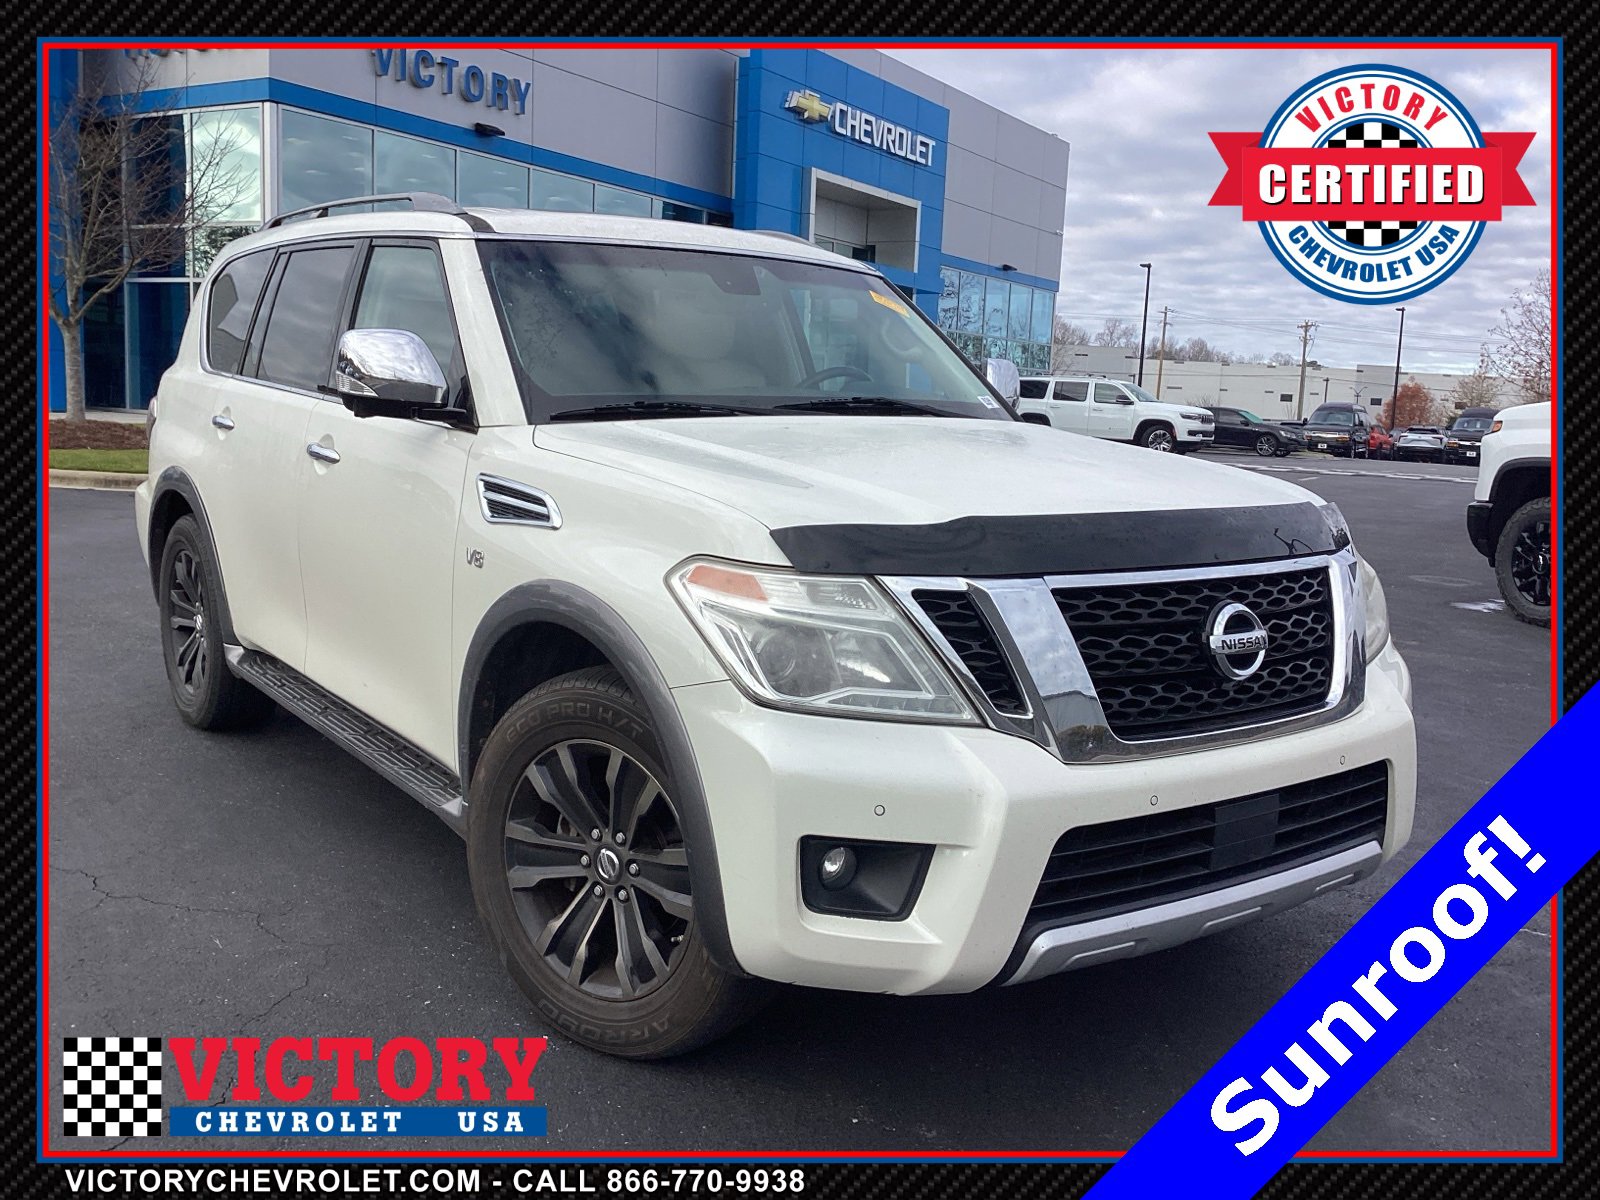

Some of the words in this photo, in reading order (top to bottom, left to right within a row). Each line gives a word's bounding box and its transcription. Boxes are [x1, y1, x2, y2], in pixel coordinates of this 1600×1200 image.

[374, 48, 531, 115] VICTORY
[833, 102, 936, 166] CHEVROLET
[466, 546, 484, 569] V8
[1221, 634, 1267, 651] NISSAN
[506, 711, 541, 743] ECO
[546, 702, 590, 718] PRO
[599, 704, 643, 740] H/T
